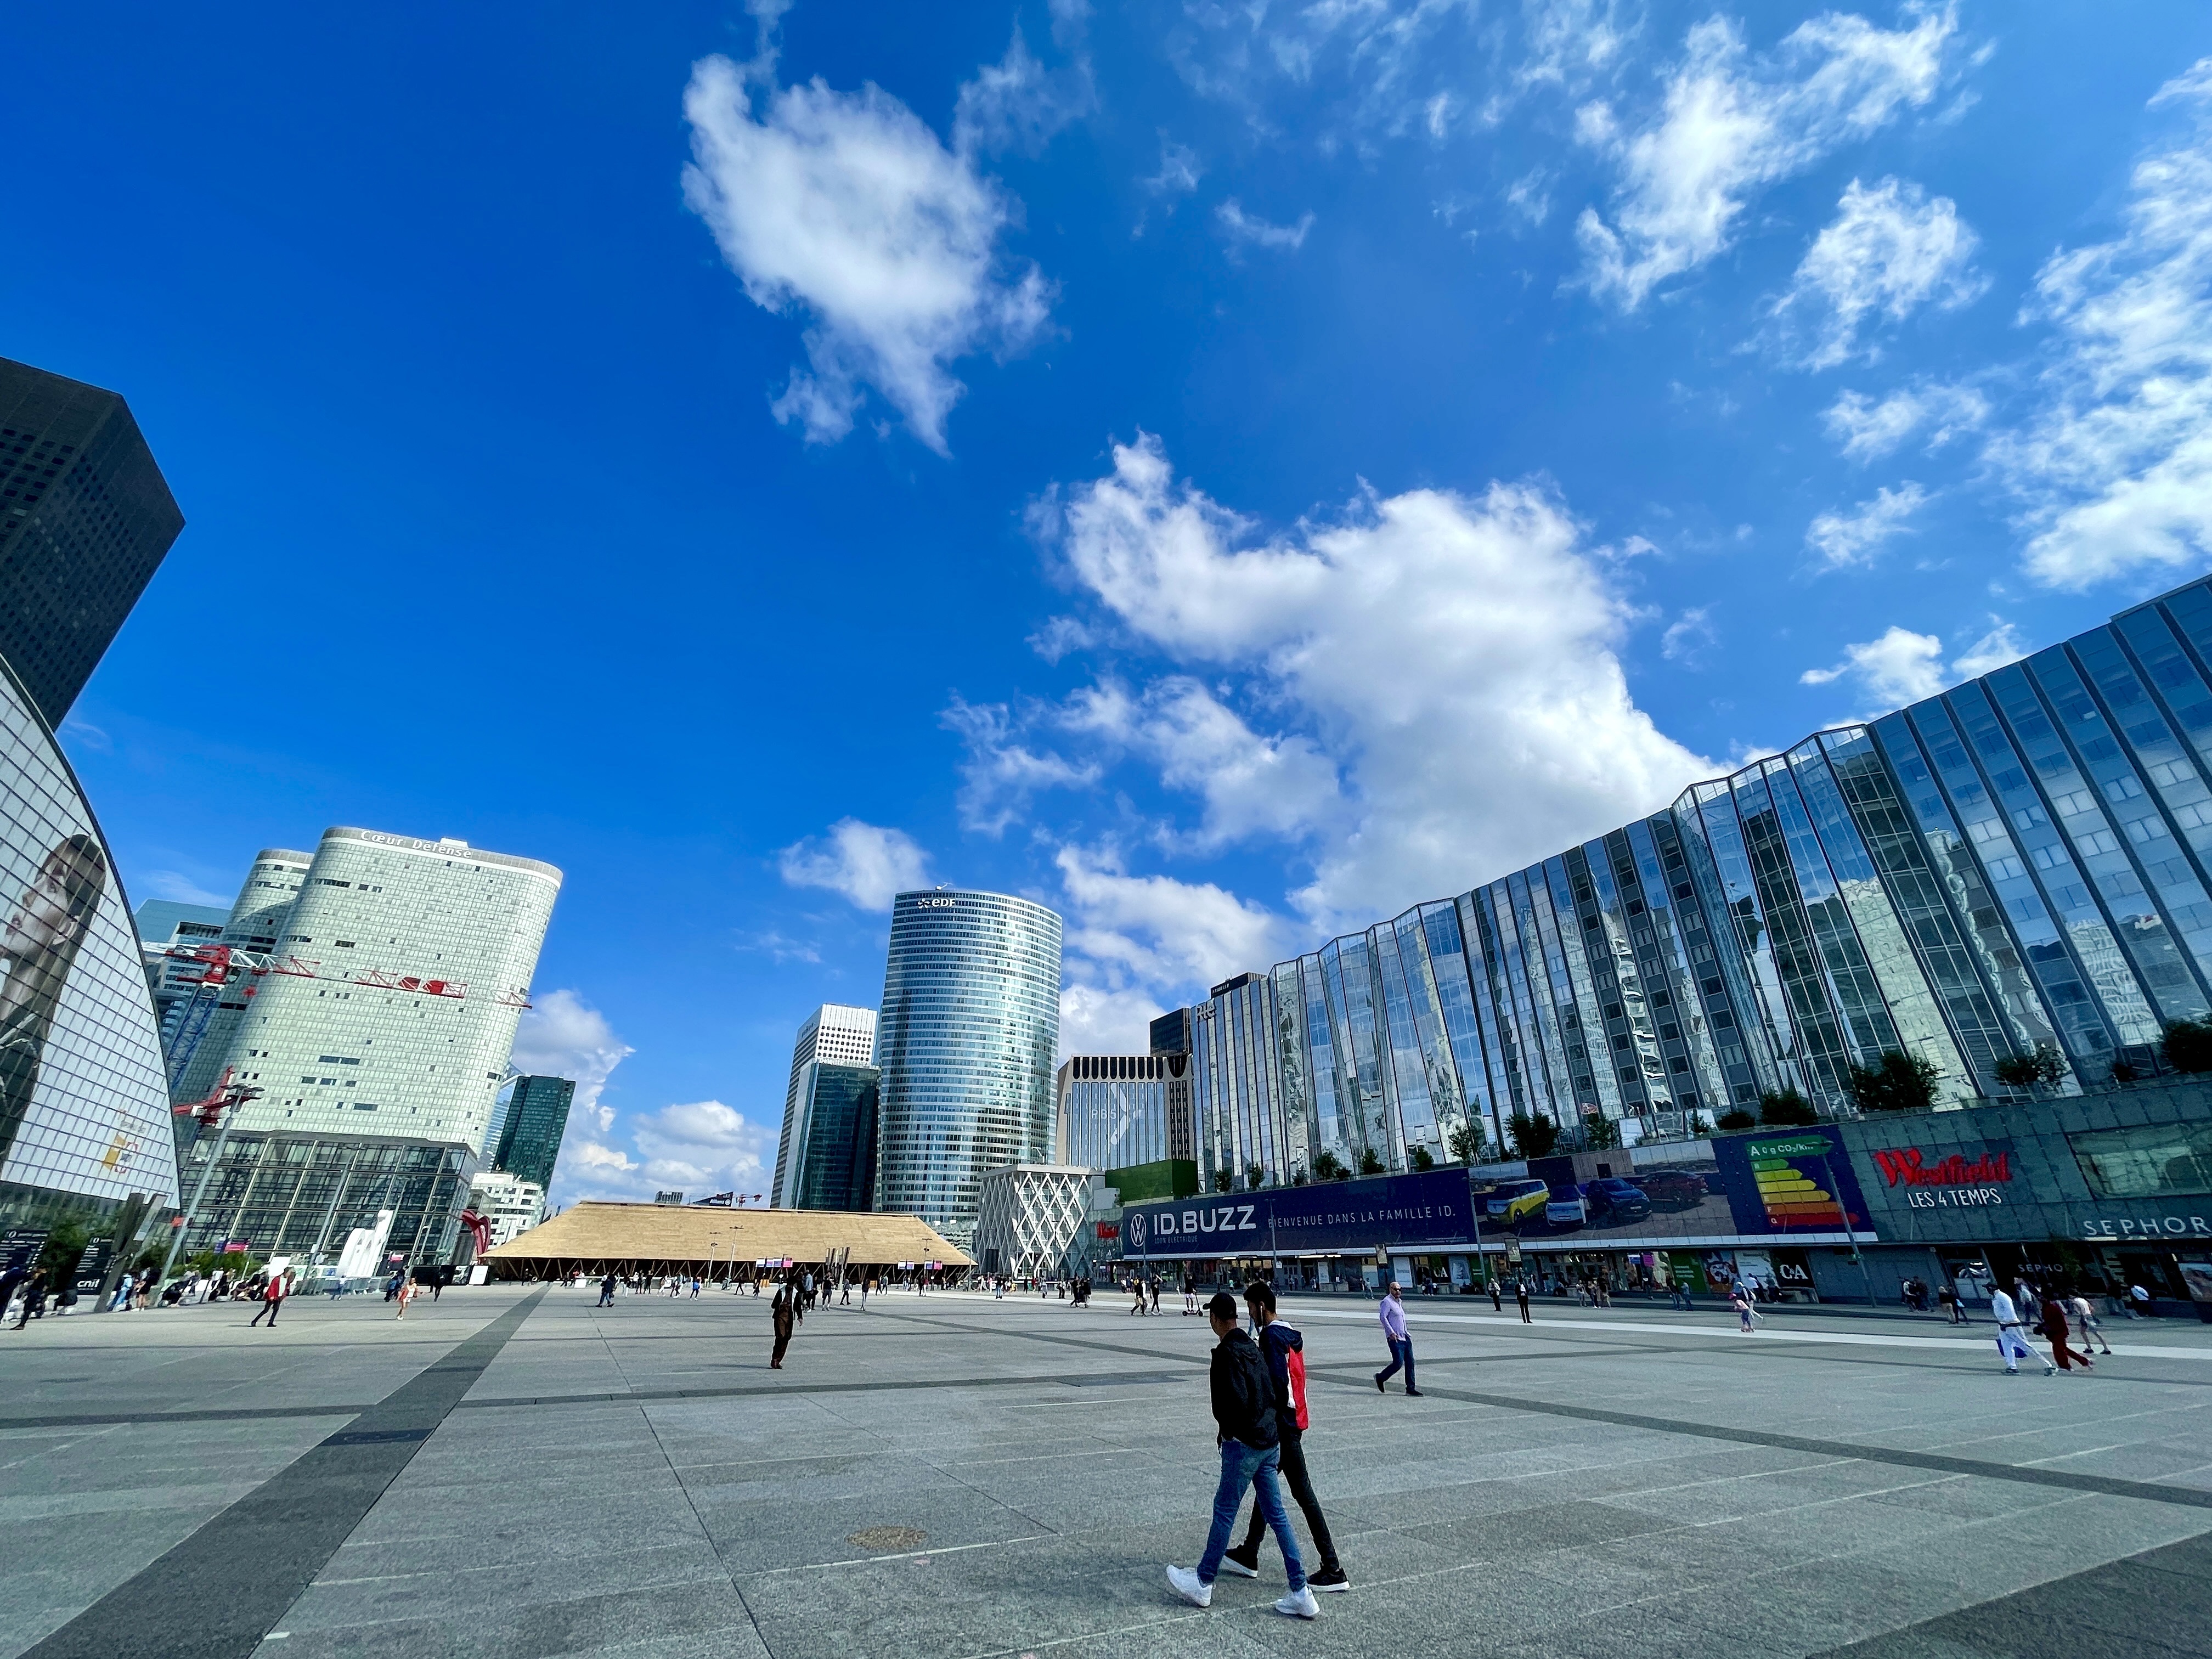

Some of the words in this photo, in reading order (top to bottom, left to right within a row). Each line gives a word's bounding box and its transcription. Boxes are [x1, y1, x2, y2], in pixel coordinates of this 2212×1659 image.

[361, 831, 403, 846] Cœur
[413, 839, 471, 858] Défense
[1751, 1146, 1760, 1156] A
[1873, 1148, 2012, 1188] Westfield
[1908, 1192, 1934, 1207] LES
[1938, 1191, 1947, 1207] 4
[1948, 1188, 2001, 1206] TEMPS
[1268, 1215, 1323, 1228] BIENVENUE
[1328, 1212, 1356, 1224] DANS
[1361, 1211, 1374, 1222] LA
[1379, 1207, 1432, 1221] FAMILLE
[2083, 1217, 2212, 1235] SEPHOR
[1780, 1265, 1809, 1279] C&A
[77, 1278, 100, 1288] cnit
